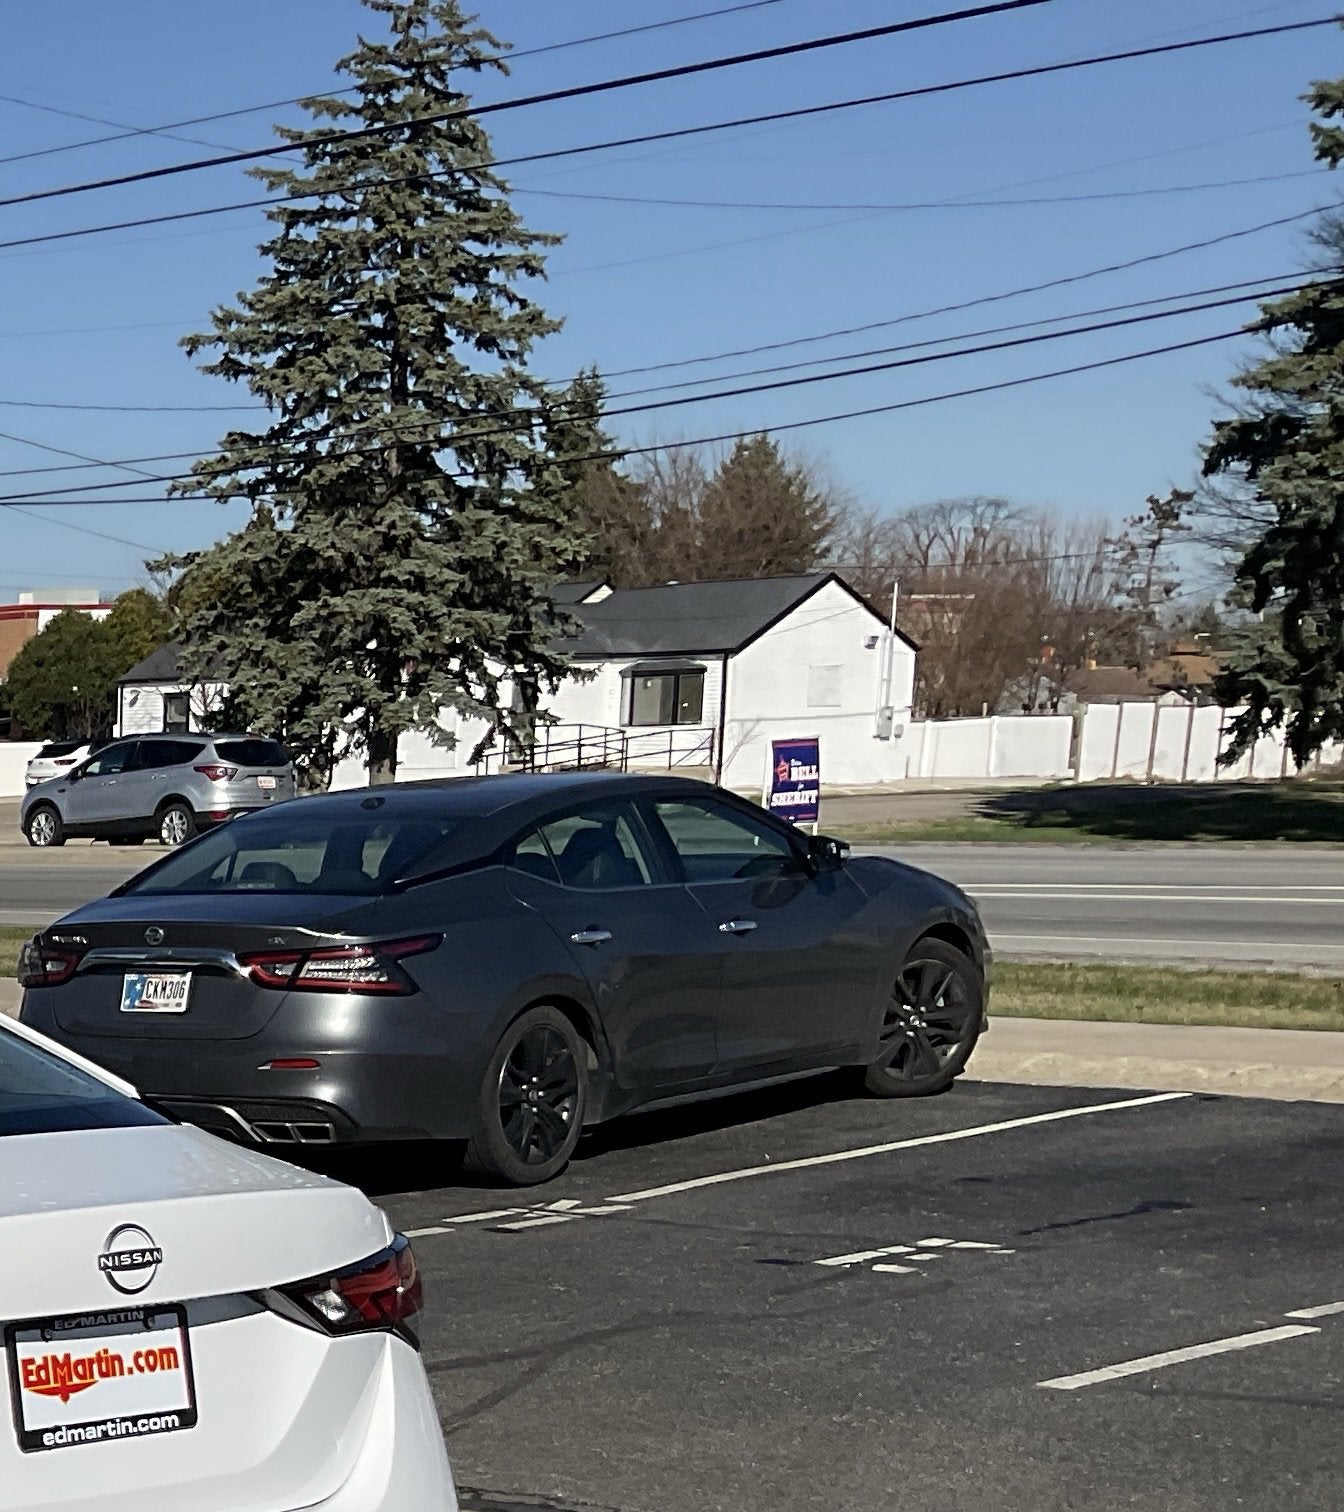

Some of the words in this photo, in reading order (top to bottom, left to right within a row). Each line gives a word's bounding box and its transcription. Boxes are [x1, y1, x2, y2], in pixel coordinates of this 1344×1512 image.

[771, 790, 818, 807] SHERIFF
[100, 1250, 162, 1268] NISSAN
[80, 1310, 145, 1327] MARTIN
[20, 1347, 179, 1390] EdMartin.com
[42, 1414, 180, 1446] edmartin.com
